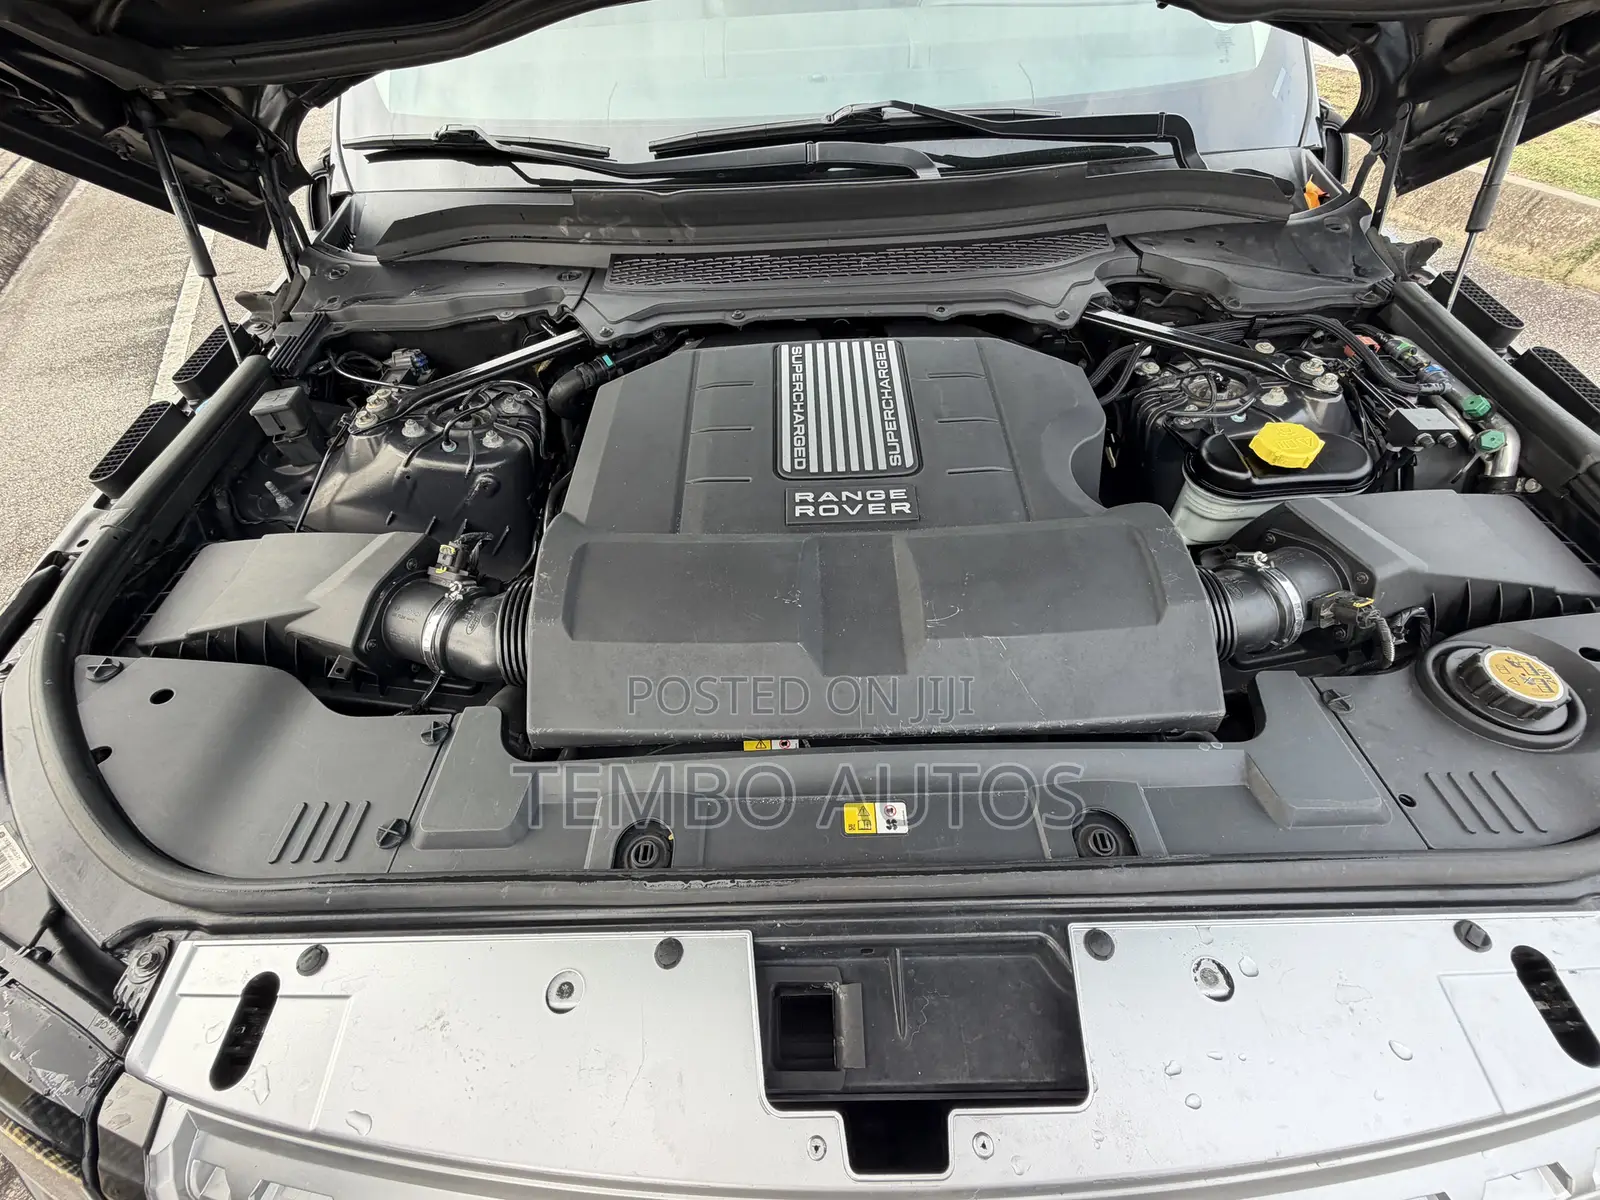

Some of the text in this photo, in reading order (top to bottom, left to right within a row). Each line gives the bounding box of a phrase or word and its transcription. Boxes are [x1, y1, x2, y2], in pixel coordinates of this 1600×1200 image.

[791, 345, 807, 470] SUPERCHARGED
[874, 343, 902, 467] SUPERCHARGED
[794, 489, 908, 503] RANGE
[794, 502, 912, 517] ROVER
